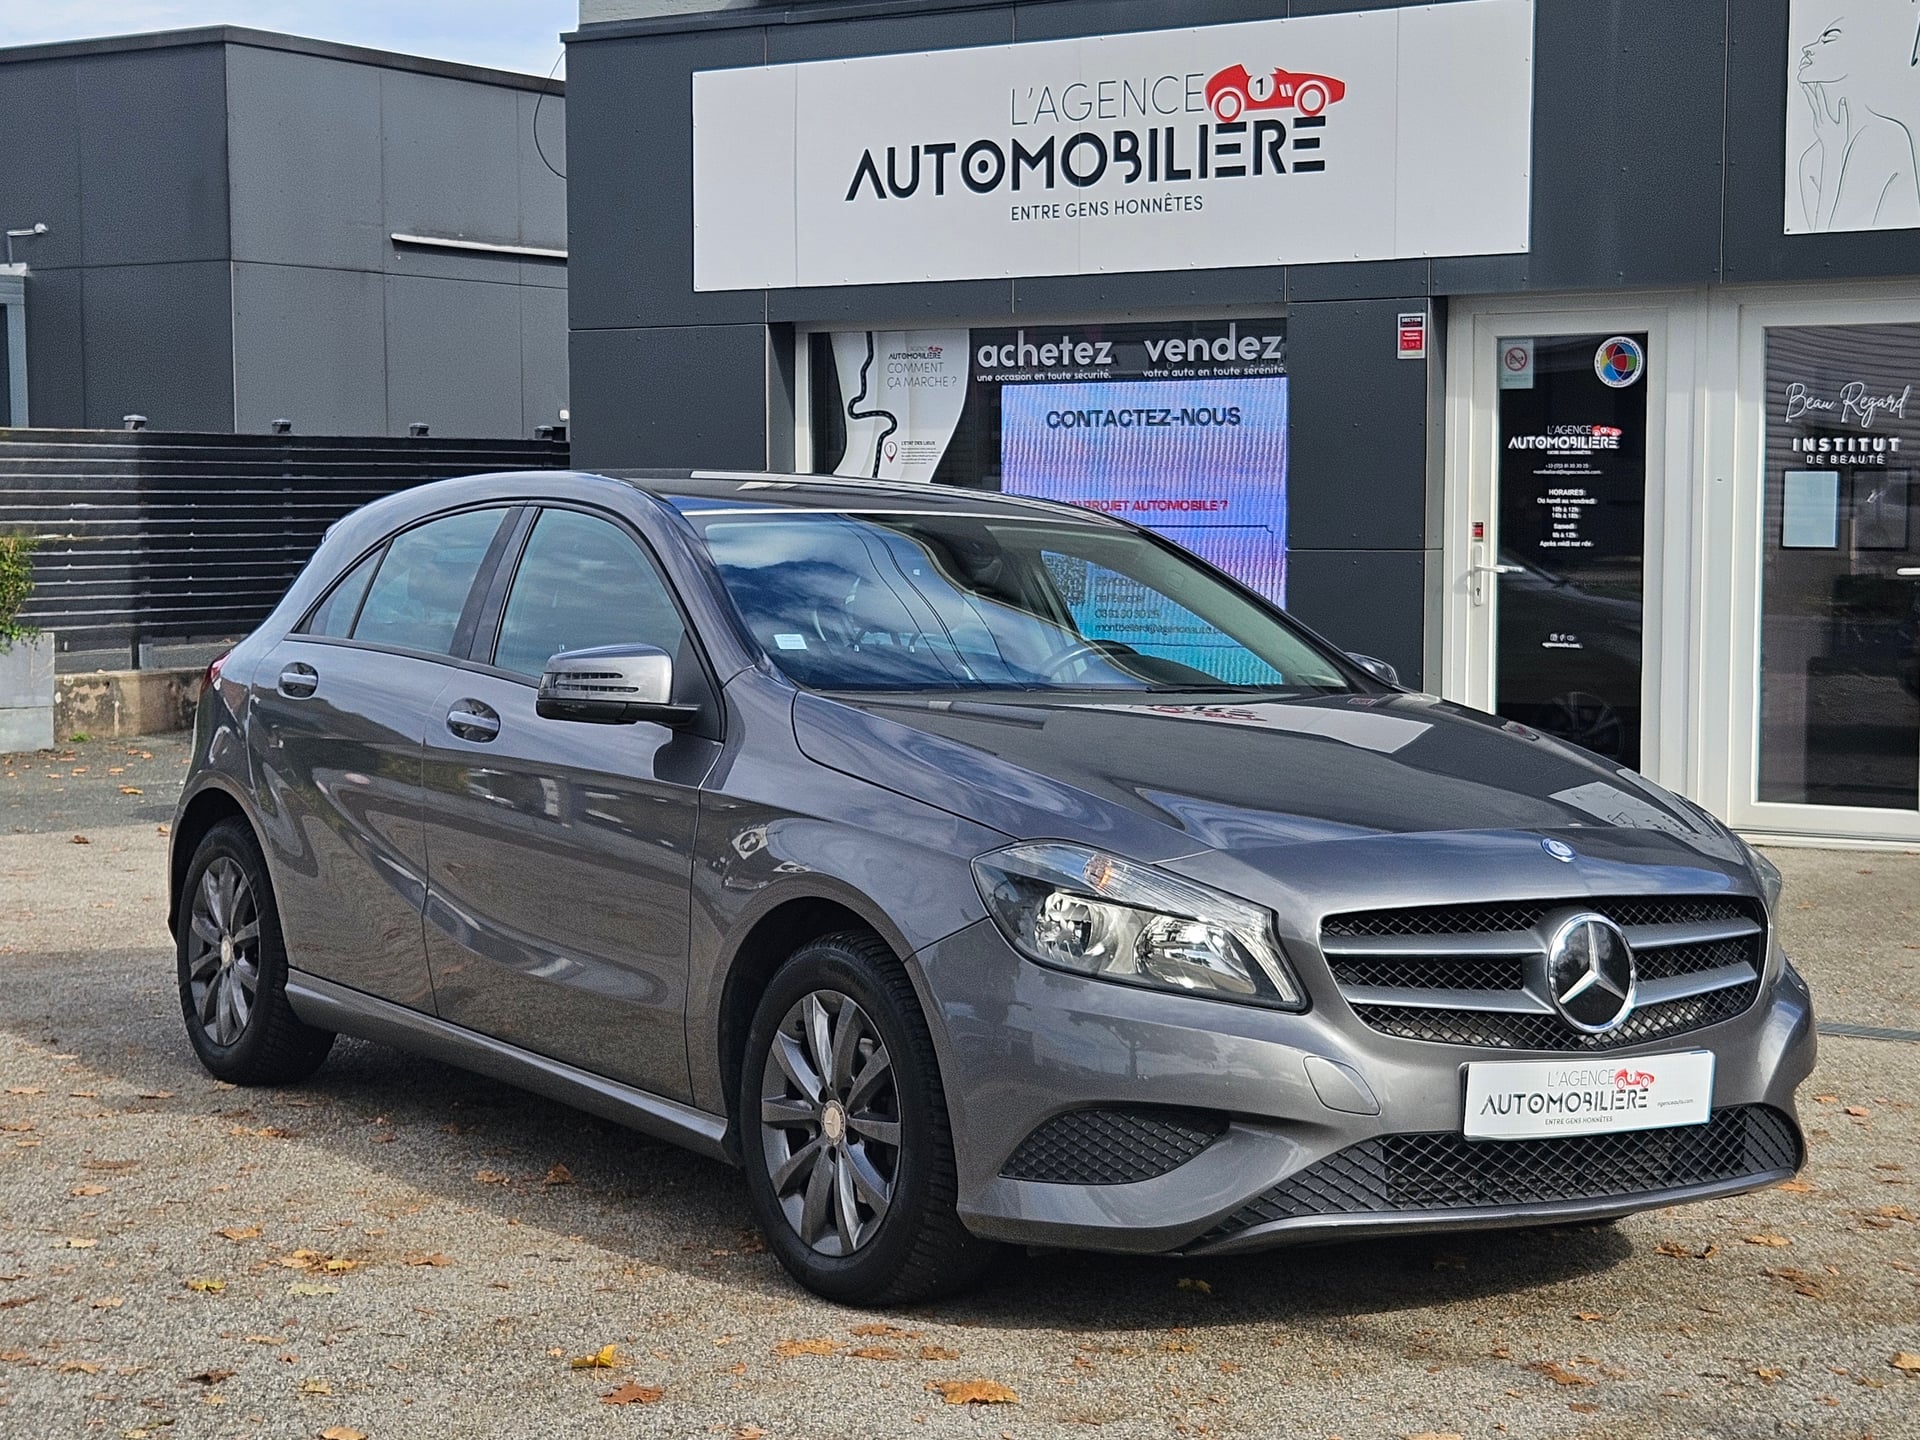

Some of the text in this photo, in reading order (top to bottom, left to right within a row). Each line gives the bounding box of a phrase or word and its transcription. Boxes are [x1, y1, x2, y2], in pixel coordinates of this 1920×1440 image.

[1011, 73, 1204, 126] L'AGENCE
[1011, 192, 1203, 221] ENTRE GENS HONNÊTES
[976, 322, 1283, 368] achetez vendez
[887, 361, 945, 374] COMMENT
[994, 371, 1031, 381] occasion
[1048, 371, 1071, 380] toute
[1074, 369, 1112, 380] sécurité.
[1143, 363, 1287, 377] votre auto en toute sérénité.
[887, 375, 957, 390] ÇA MARCHE ?
[1785, 381, 1910, 428] Beau Regard
[1046, 407, 1241, 429] CONTACTEZ-NOUS
[1547, 425, 1592, 435] L'AGENCE
[1792, 437, 1901, 452] INSTITUT
[1806, 453, 1886, 465] DE BEAUTÉ
[1084, 500, 1129, 512] PROJET
[1132, 500, 1218, 511] AUTOMOBILE
[1220, 500, 1228, 511] ?
[1547, 1068, 1616, 1088] L'AGENCE
[1565, 1117, 1581, 1125] GENS
